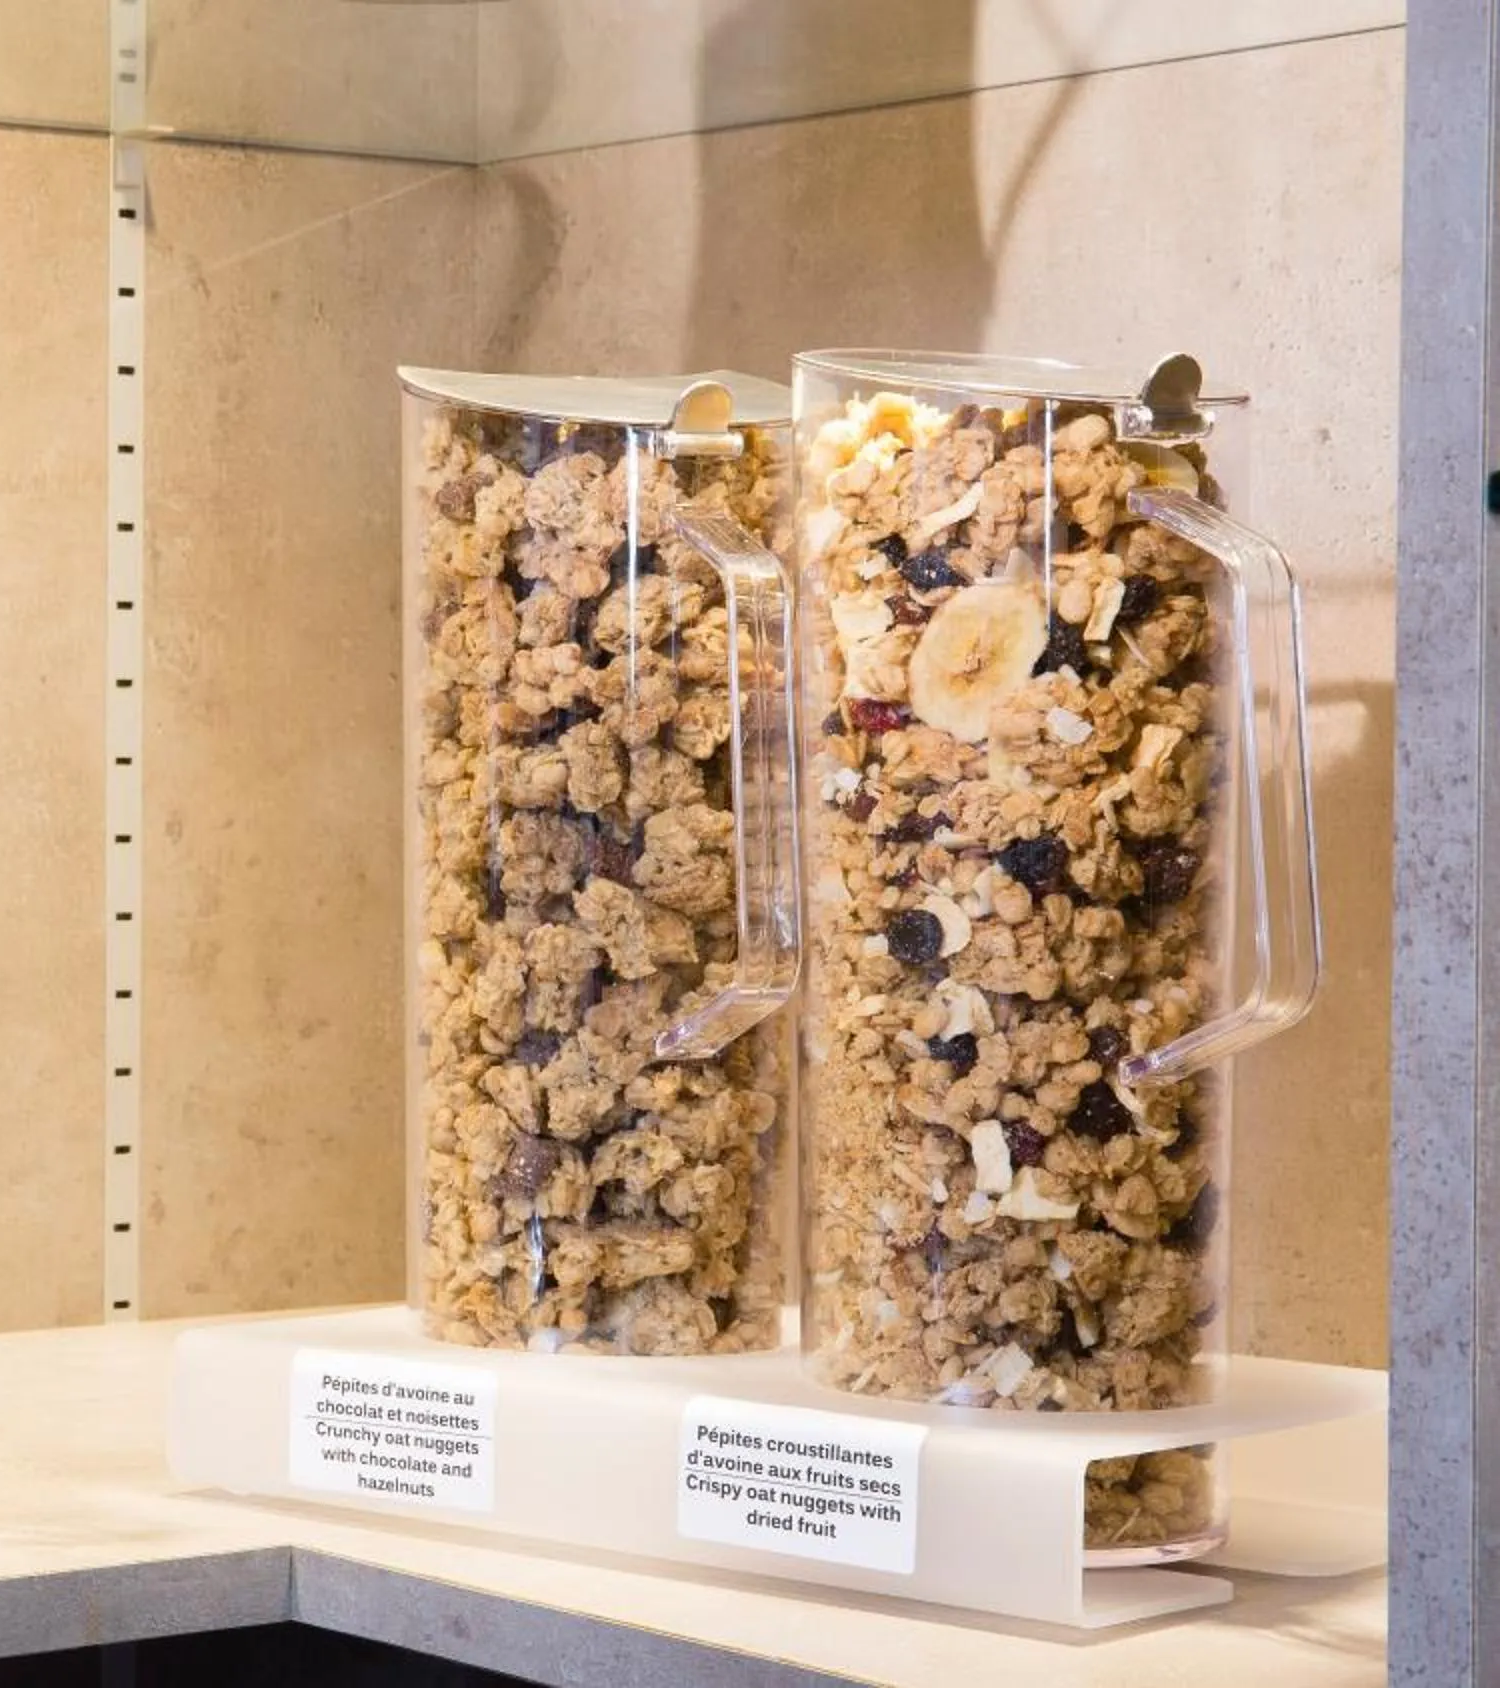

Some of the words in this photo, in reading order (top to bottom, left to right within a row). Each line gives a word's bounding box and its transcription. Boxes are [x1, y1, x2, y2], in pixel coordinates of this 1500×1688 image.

[323, 1375, 378, 1395] Pépites
[382, 1382, 449, 1402] d'avoine
[453, 1394, 475, 1405] au
[317, 1400, 383, 1419] chocolat
[388, 1409, 401, 1421] et
[406, 1411, 479, 1431] noisettes
[316, 1422, 380, 1446] Crunchy
[385, 1432, 410, 1446] oat
[414, 1435, 479, 1456] nuggets
[697, 1425, 762, 1449] Pépites
[767, 1437, 893, 1468] croustillantes
[322, 1448, 355, 1463] with
[360, 1452, 437, 1473] chocolate
[441, 1463, 472, 1478] and
[687, 1450, 763, 1474] d'avoine
[768, 1464, 800, 1480] aux
[806, 1467, 854, 1488] fruits
[859, 1480, 901, 1496] secs
[357, 1474, 435, 1497] hazelnuts
[686, 1474, 742, 1500] Crispy
[747, 1487, 776, 1503] oat
[781, 1492, 854, 1516] nuggets
[860, 1504, 901, 1523] with
[747, 1510, 793, 1531] dried
[797, 1517, 836, 1538] fruit
